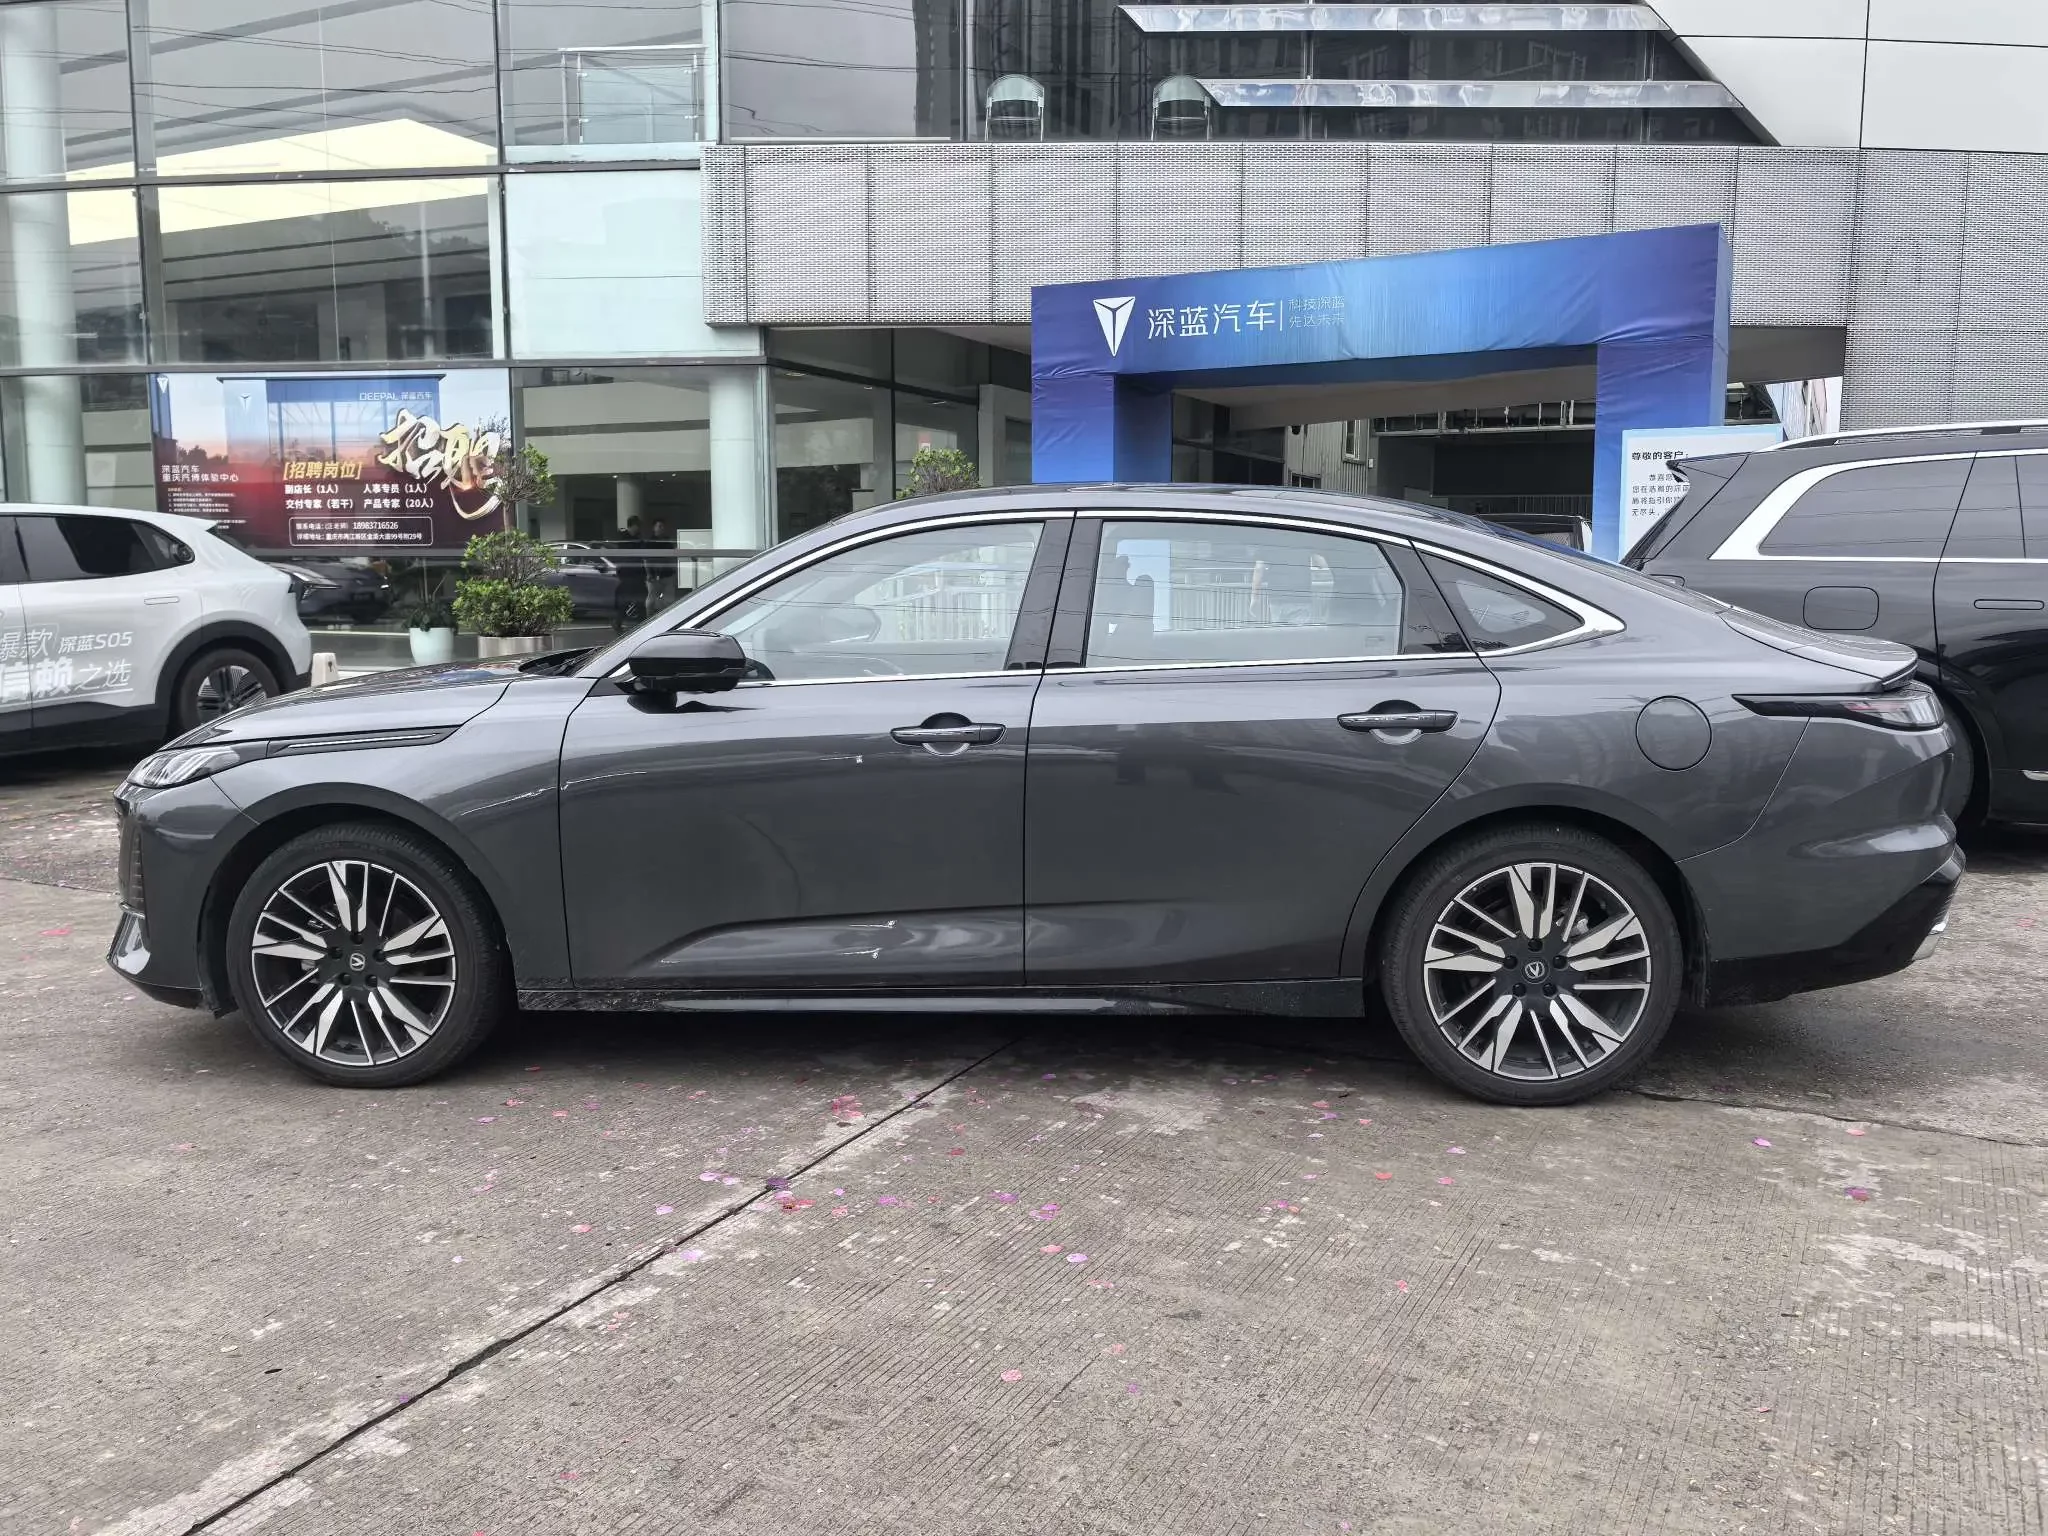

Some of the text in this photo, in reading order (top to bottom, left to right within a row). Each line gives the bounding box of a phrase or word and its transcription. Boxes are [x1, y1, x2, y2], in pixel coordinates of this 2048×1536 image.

[1288, 296, 1345, 311] 科技深蓝
[1148, 299, 1276, 339] 深蓝汽车
[359, 392, 398, 400] DEEPAL
[161, 465, 200, 473] 深蓝汽车
[353, 521, 399, 530] 18983716526
